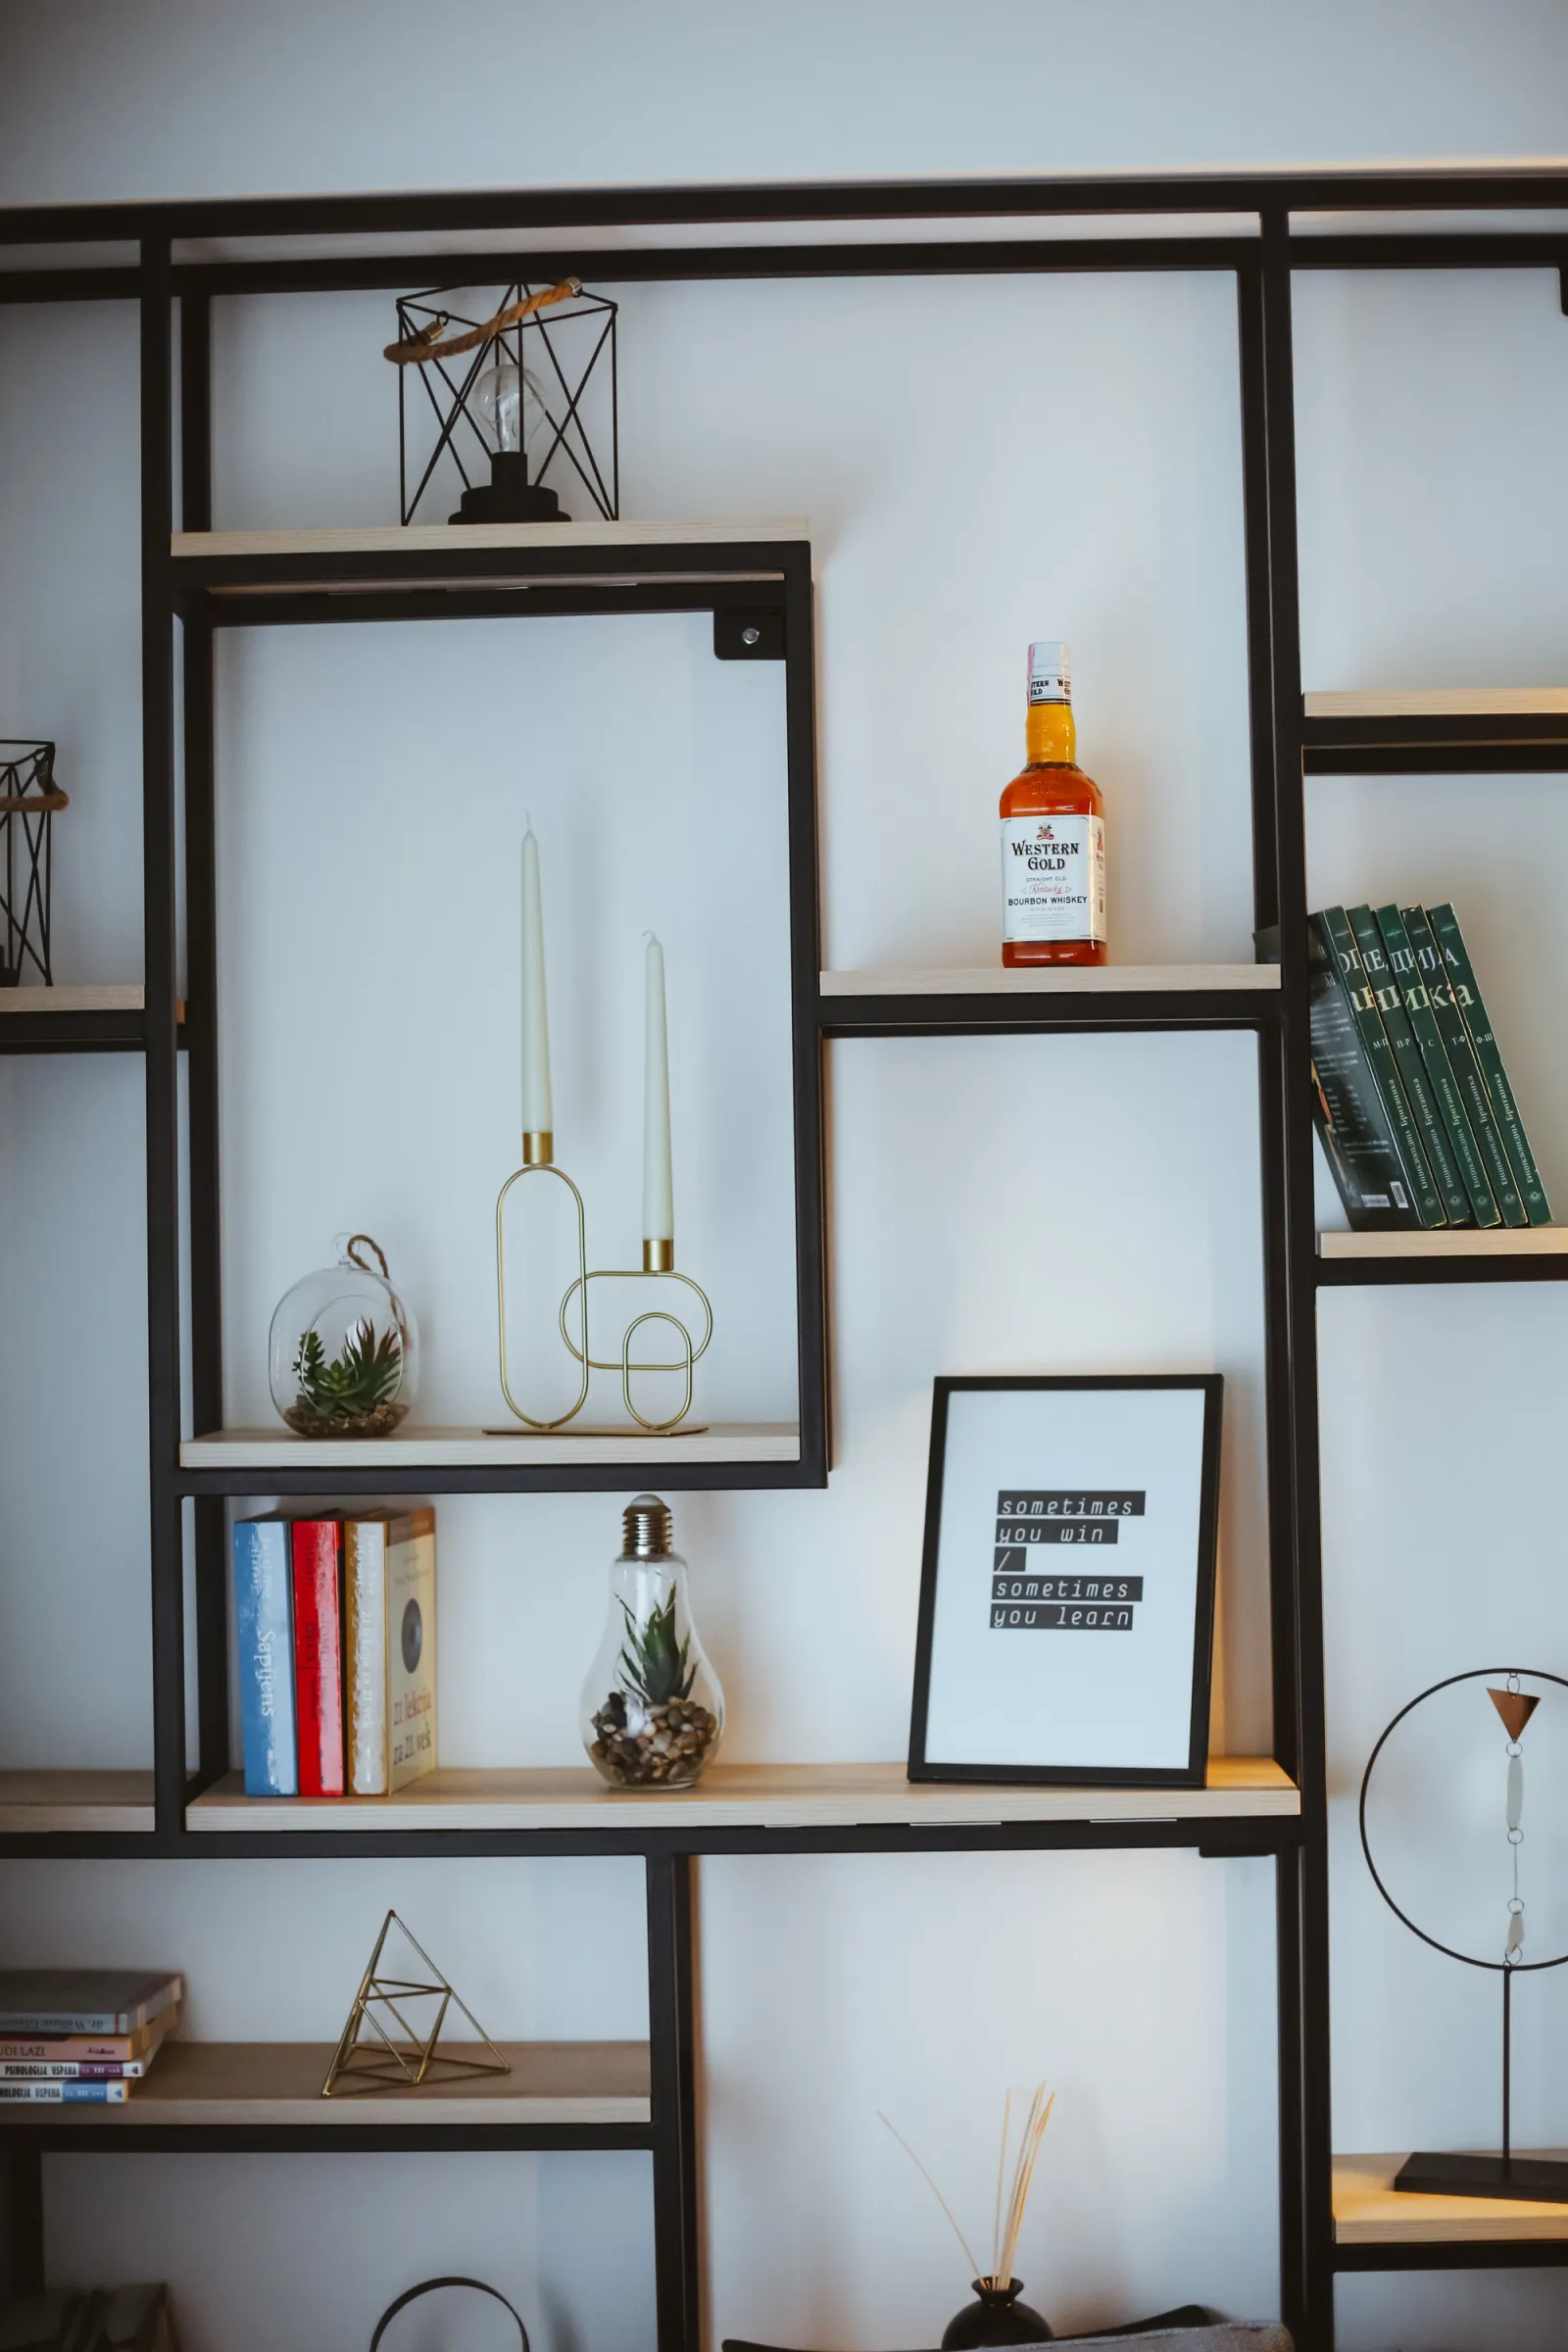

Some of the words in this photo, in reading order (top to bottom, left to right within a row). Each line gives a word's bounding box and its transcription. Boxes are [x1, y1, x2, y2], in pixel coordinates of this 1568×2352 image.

[1011, 840, 1080, 856] WESTERN
[1028, 857, 1065, 870] GOLD
[1029, 882, 1062, 894] Kentucky
[1008, 897, 1047, 906] BOURBON
[1396, 1038, 1410, 1049] П-Р
[1476, 1032, 1494, 1045] Ф-Ш
[1389, 1079, 1408, 1127] Британика
[1413, 1078, 1433, 1126] Британика
[1441, 1078, 1460, 1126] Британика
[1468, 1075, 1489, 1123] Британика
[1494, 1073, 1514, 1121] Британика
[1002, 1497, 1133, 1515] sometimes
[1000, 1527, 1042, 1544] you
[1060, 1525, 1103, 1542] win
[997, 1551, 1010, 1572] /
[997, 1580, 1128, 1597] sometimes
[994, 1609, 1037, 1628] you
[1056, 1606, 1129, 1626] learn
[254, 1630, 275, 1716] Sapijens
[5, 2066, 47, 2076] PSIHOLOGIJA
[52, 2066, 77, 2076] USPEHA
